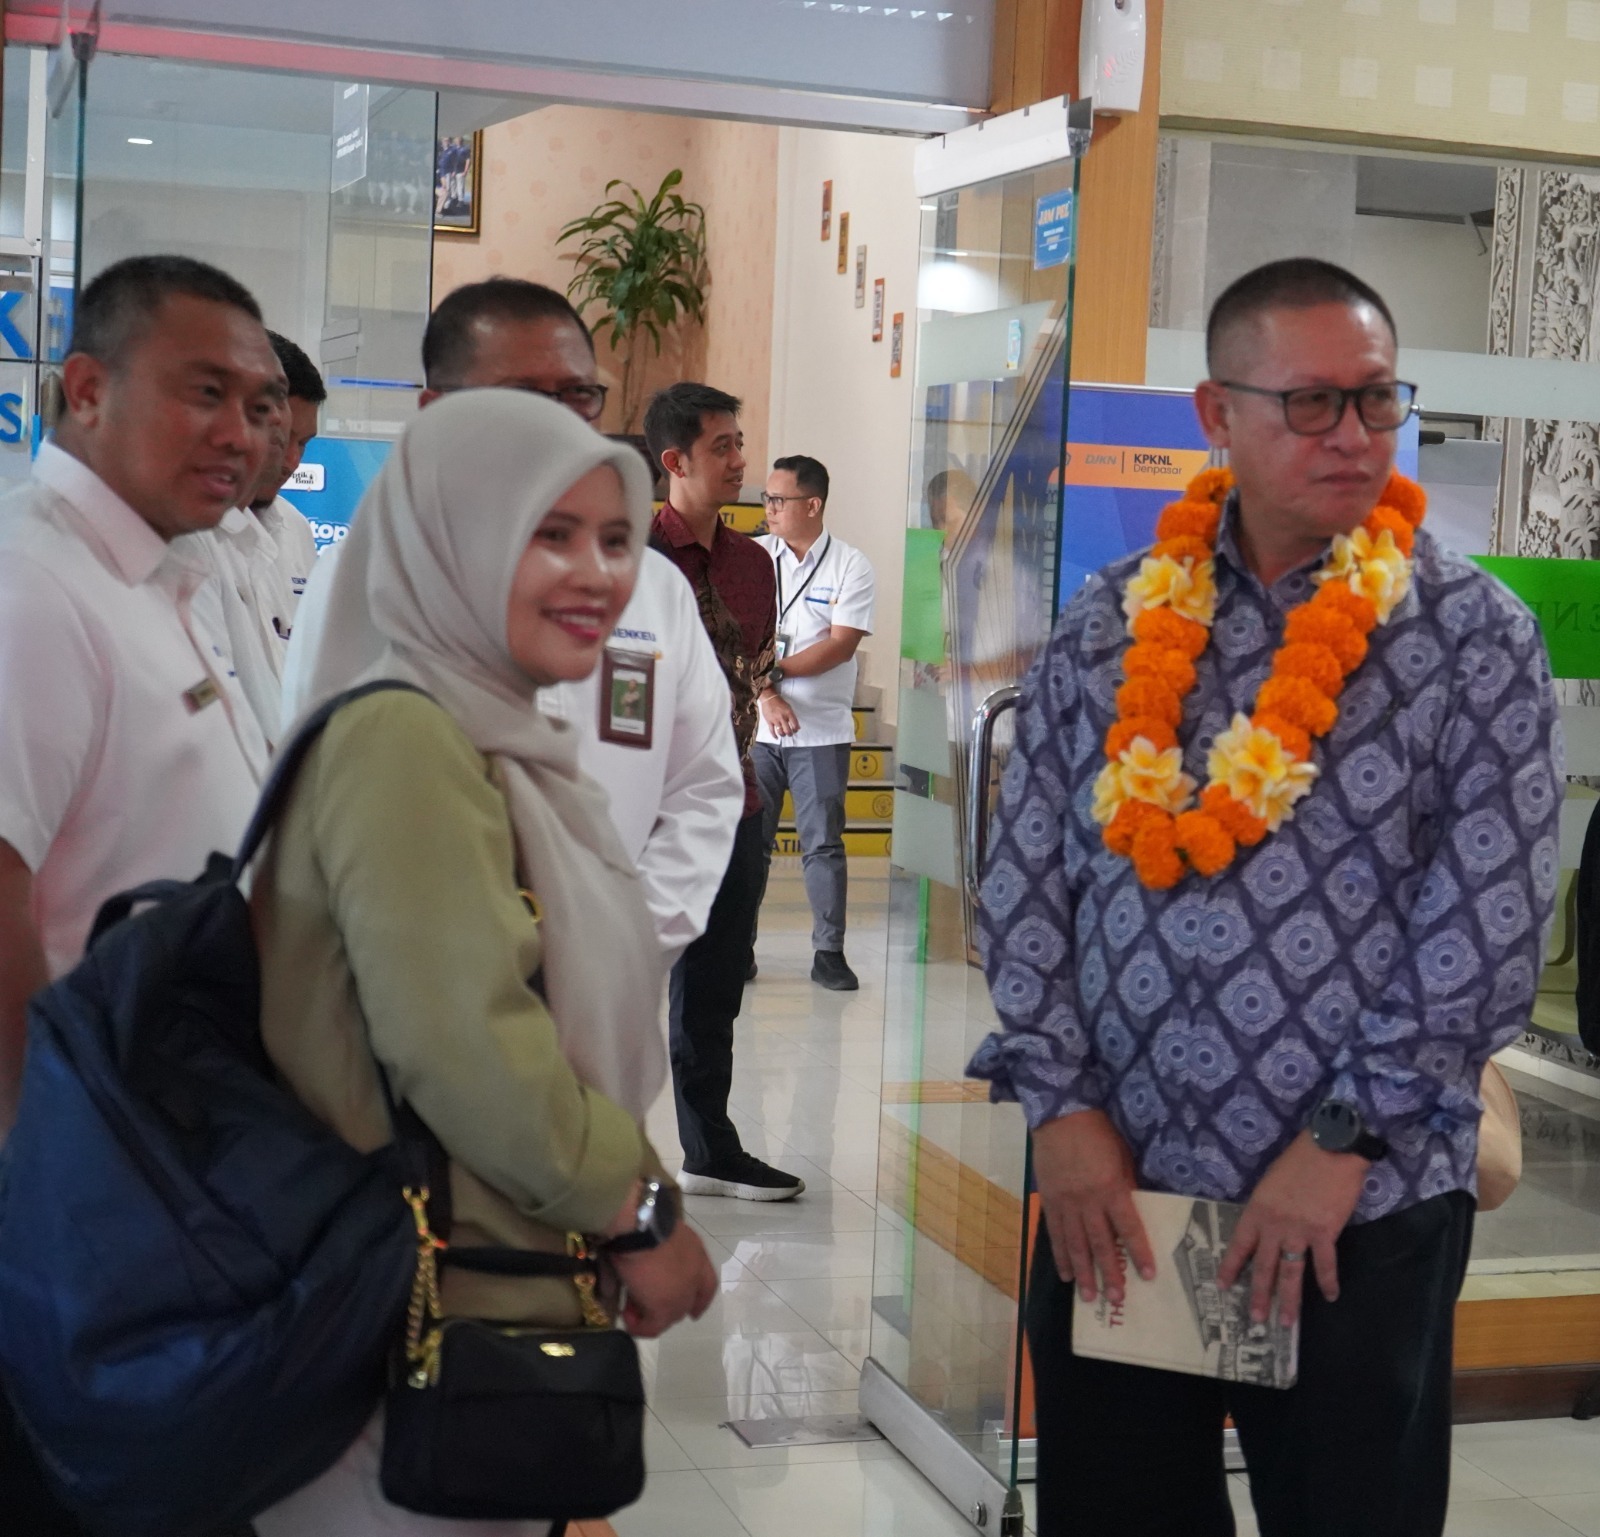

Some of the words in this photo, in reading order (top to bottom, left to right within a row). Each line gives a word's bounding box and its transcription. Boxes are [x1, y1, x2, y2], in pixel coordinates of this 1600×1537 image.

[1085, 453, 1117, 465] DJKN
[1134, 453, 1172, 466] KPKNL
[1133, 463, 1182, 475] Denpasar
